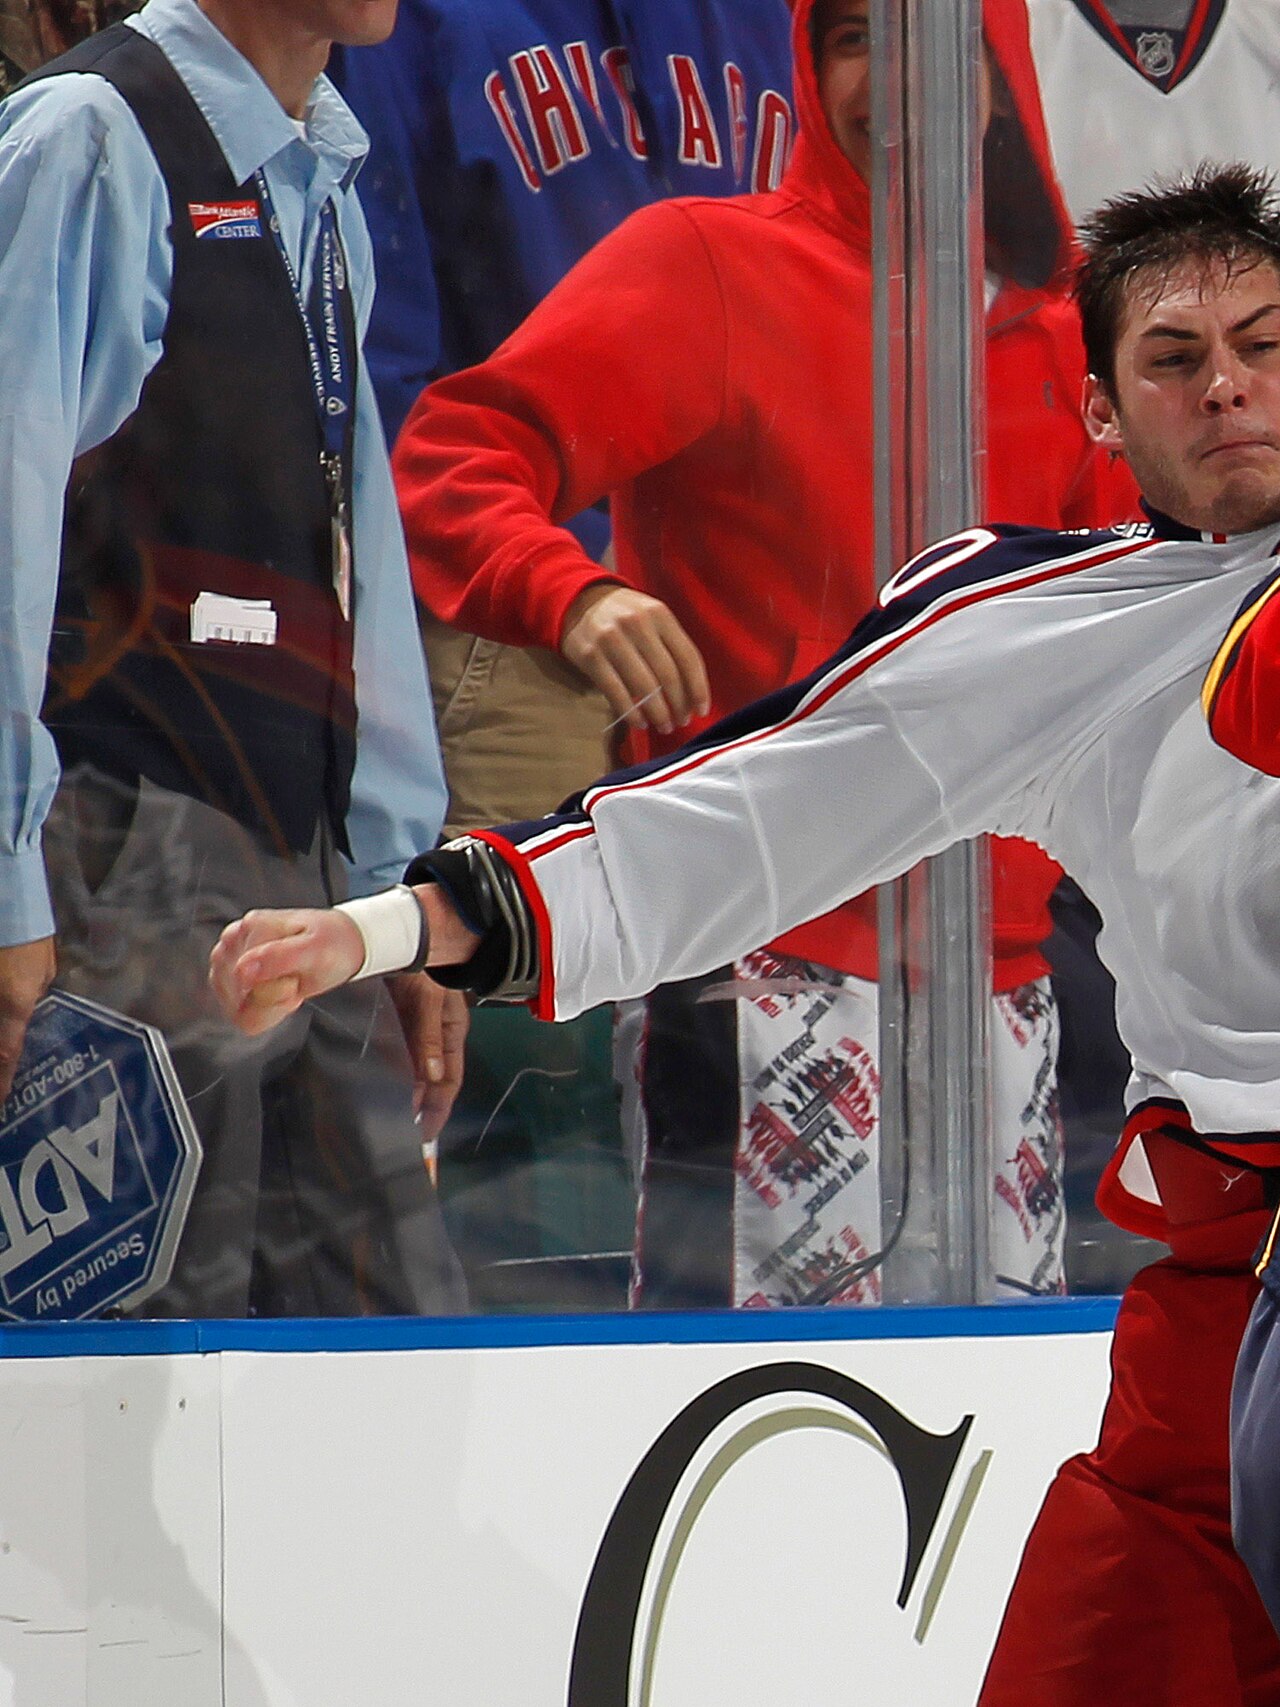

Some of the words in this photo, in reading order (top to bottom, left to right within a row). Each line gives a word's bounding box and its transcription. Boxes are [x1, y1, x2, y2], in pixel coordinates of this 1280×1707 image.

[215, 226, 262, 238] CENTER
[323, 301, 338, 343] FRAIN
[328, 345, 342, 383] ANDY
[0, 1089, 120, 1280] ADT
[62, 1232, 146, 1300] Secured
[36, 1286, 62, 1315] by
